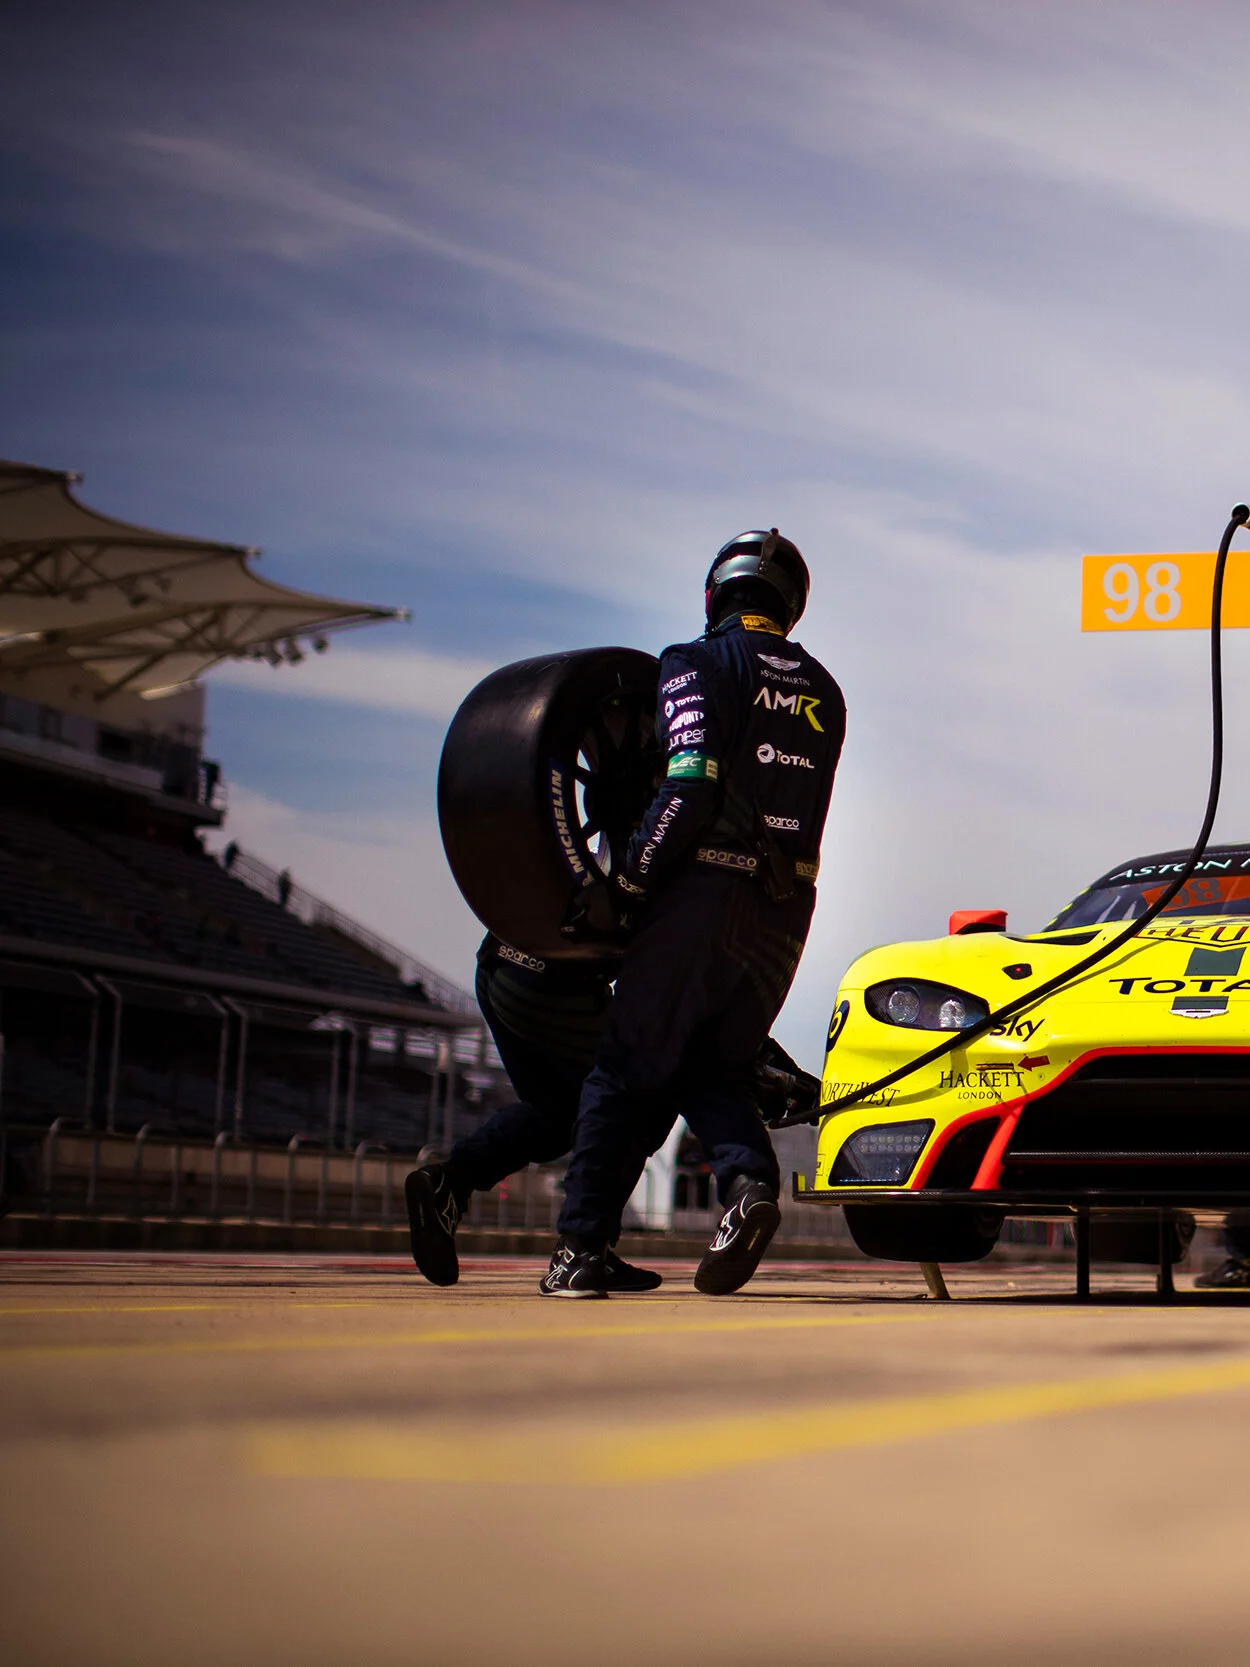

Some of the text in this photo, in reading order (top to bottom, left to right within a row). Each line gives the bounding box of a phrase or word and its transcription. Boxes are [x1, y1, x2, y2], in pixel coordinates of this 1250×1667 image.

[1102, 561, 1182, 623] 98
[675, 695, 704, 708] TOTAL
[753, 686, 824, 733] AMR
[776, 750, 815, 769] TOTAL
[552, 769, 584, 873] MICHELIN
[764, 815, 800, 831] sparco
[640, 842, 656, 874] STON
[652, 796, 683, 843] MARTIN
[698, 848, 757, 870] sparco
[1110, 859, 1222, 881] ASTON
[498, 944, 546, 973] sparco
[990, 1016, 1045, 1042] sky
[939, 1071, 1024, 1089] HACKETT
[958, 1090, 1003, 1100] LONDON
